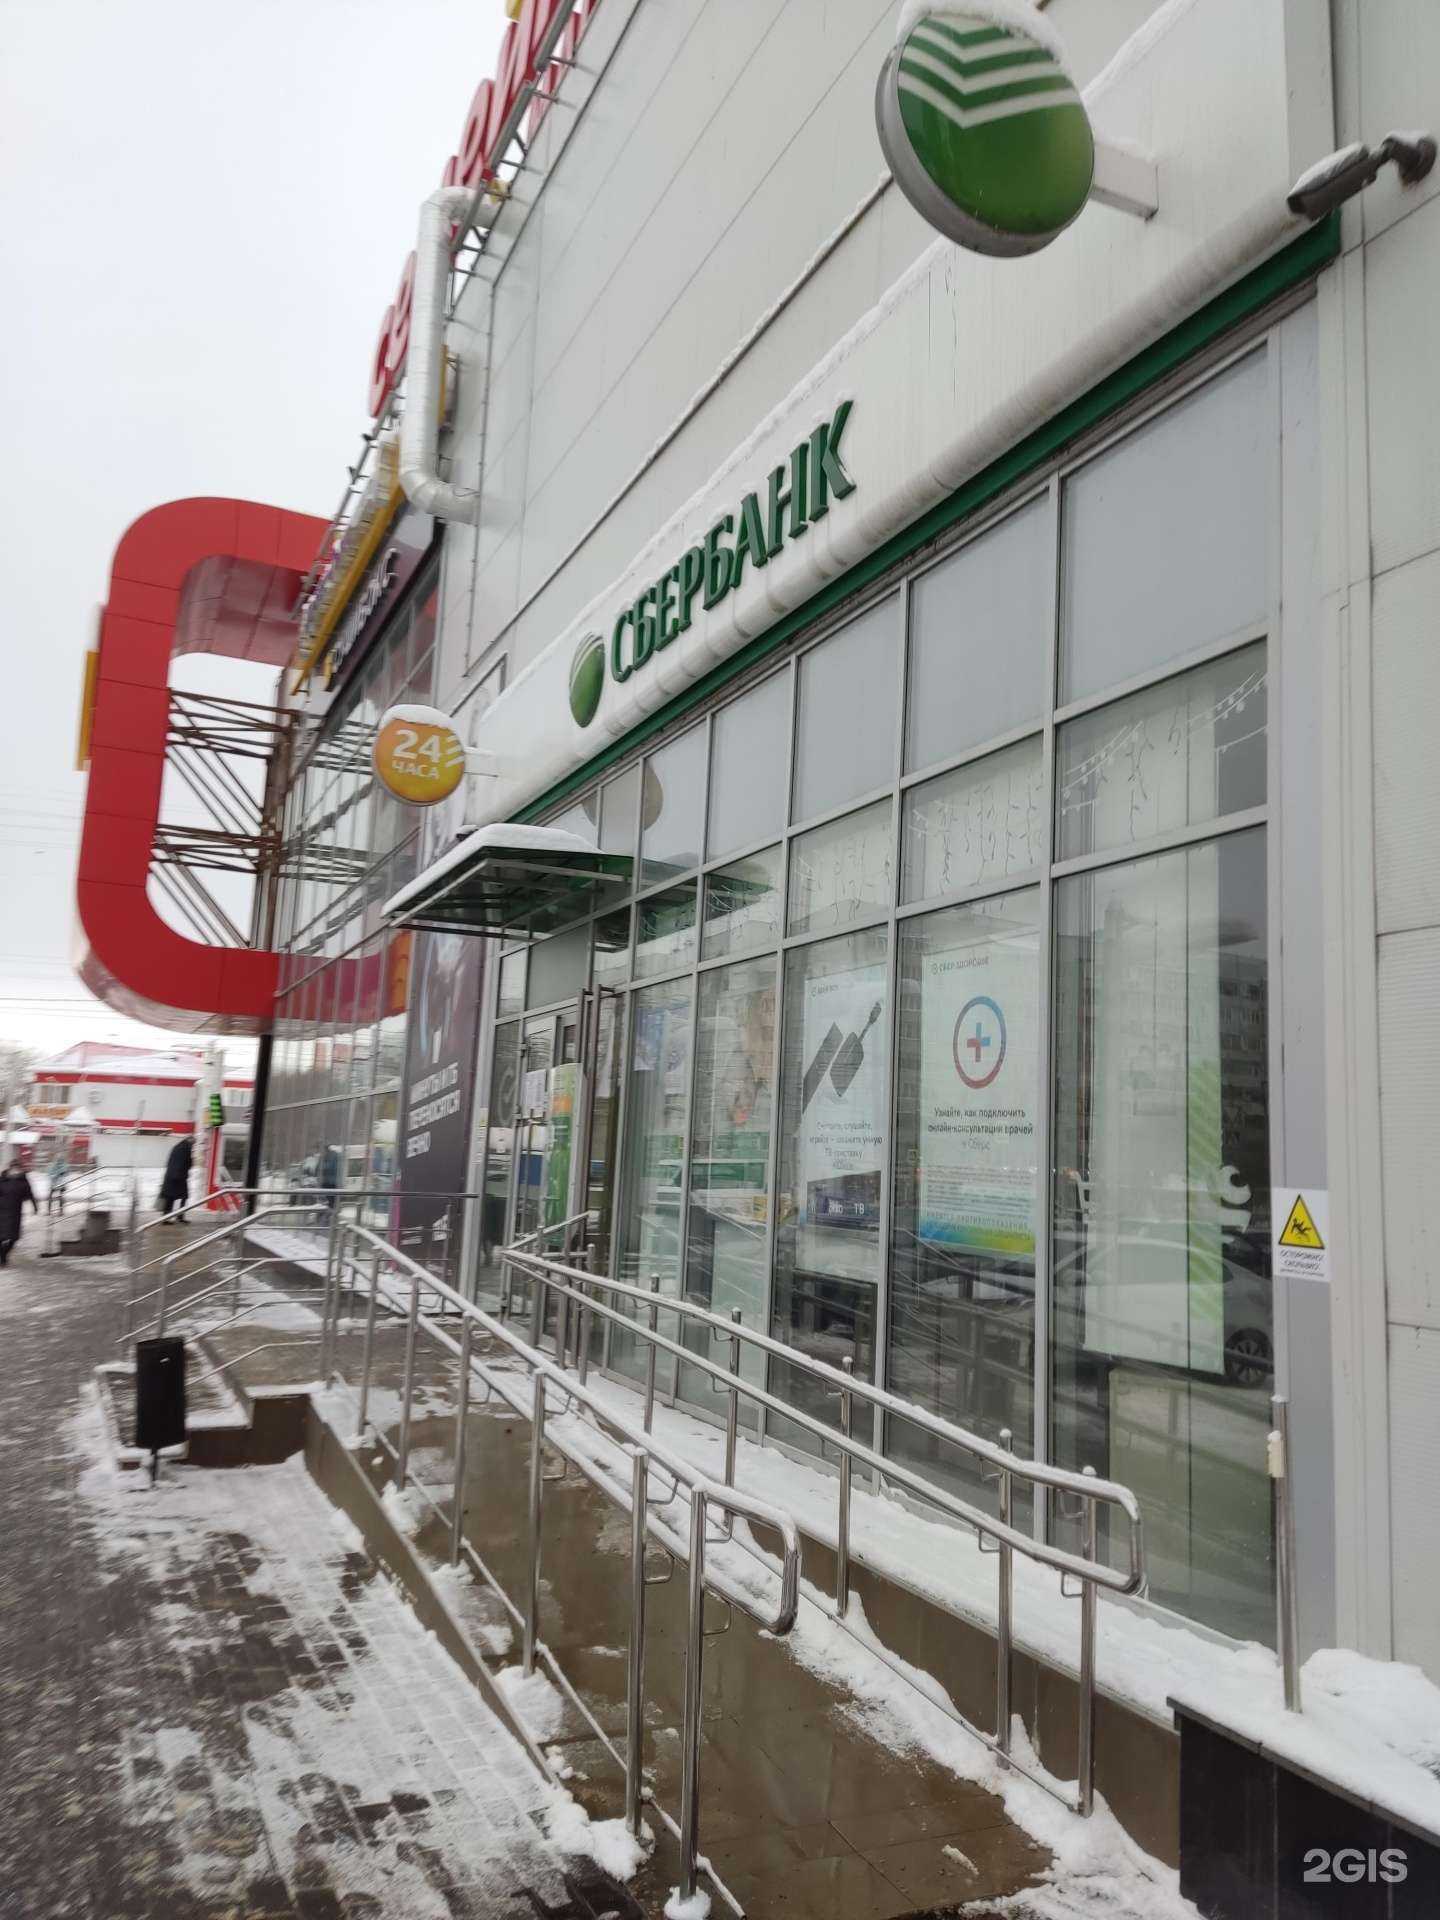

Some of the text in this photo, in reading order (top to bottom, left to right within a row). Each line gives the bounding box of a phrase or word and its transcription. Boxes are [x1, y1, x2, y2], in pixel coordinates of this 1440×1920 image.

[611, 400, 857, 683] СБЕРБАНК
[392, 729, 440, 763] 24
[391, 760, 440, 779] ЧАСА
[979, 1108, 1026, 1119] подключить
